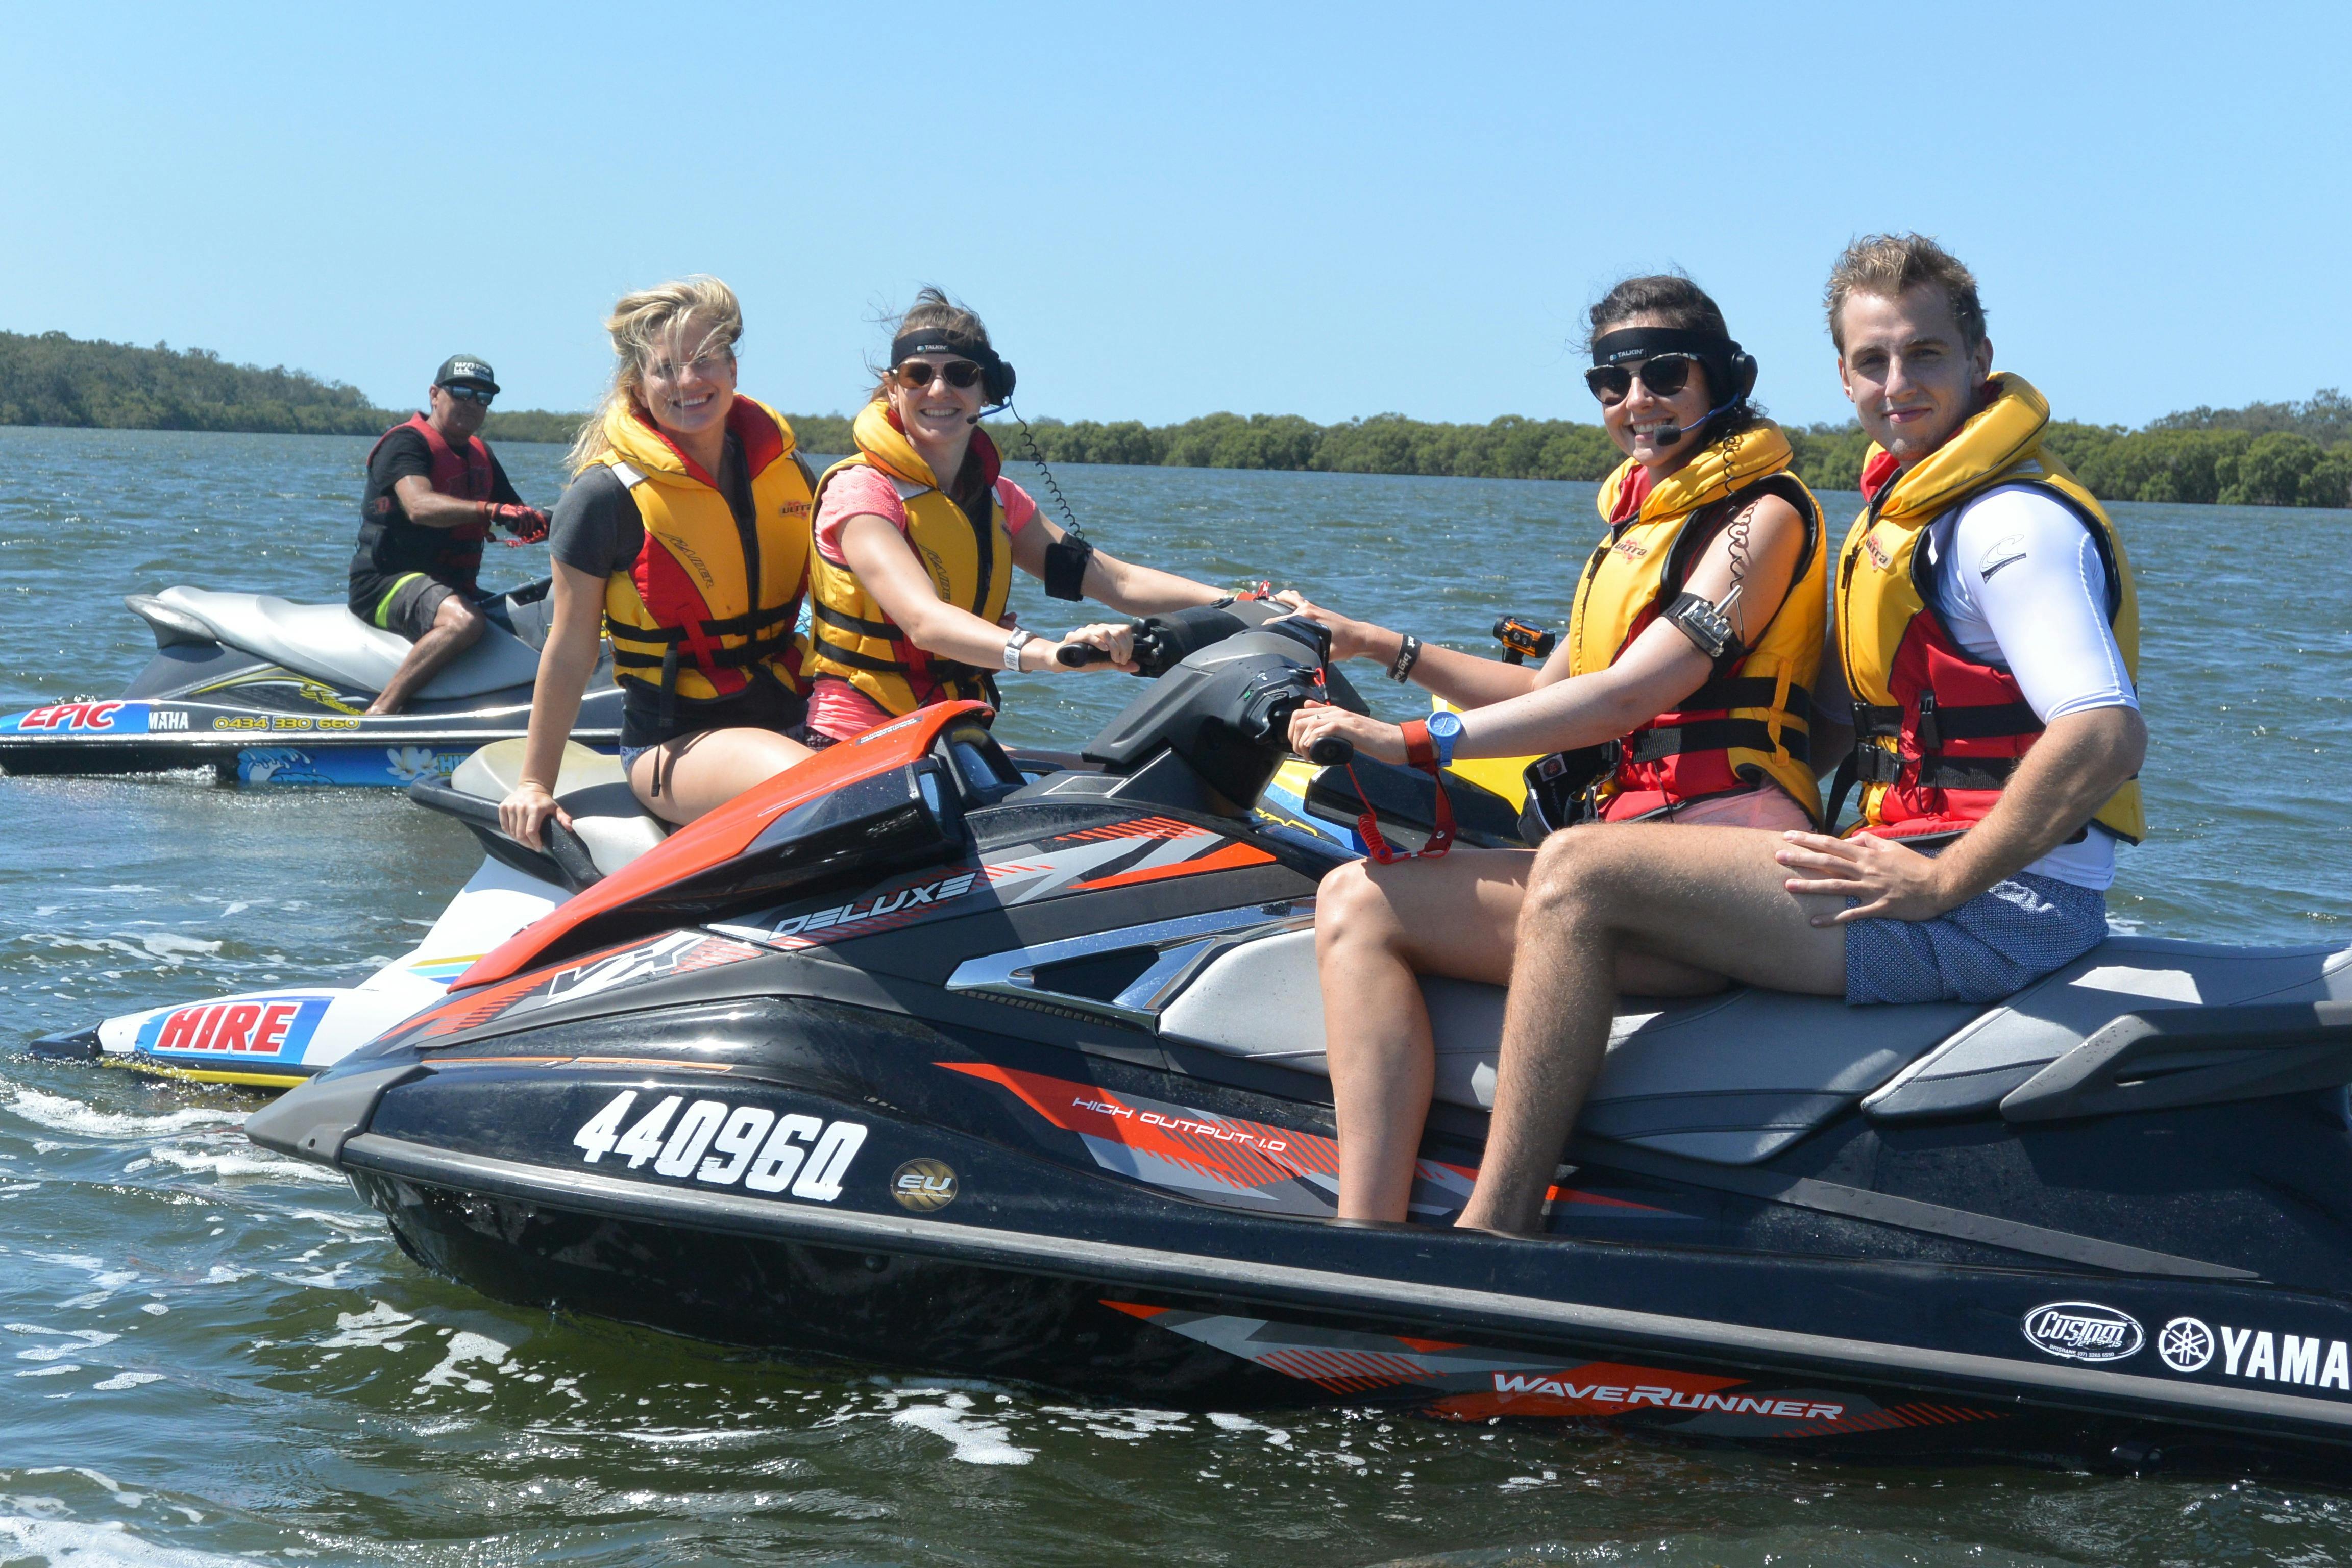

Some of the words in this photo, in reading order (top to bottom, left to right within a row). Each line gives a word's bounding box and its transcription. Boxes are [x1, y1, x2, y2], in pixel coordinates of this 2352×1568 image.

[918, 544, 951, 601] RAIDE
[19, 701, 124, 729] EPIC
[214, 717, 268, 730] 0434
[273, 717, 312, 730] 330
[317, 717, 360, 730] 660
[769, 872, 977, 939] DELUXE
[155, 1003, 300, 1055] HIRE
[1072, 1097, 1134, 1119] HIGH
[1139, 1112, 1254, 1143] OUTPUT
[1258, 1138, 1287, 1152] 1.0
[897, 1174, 952, 1190] EU
[2049, 1344, 2076, 1356] BRISBANE
[2221, 1326, 2350, 1390] YAMA
